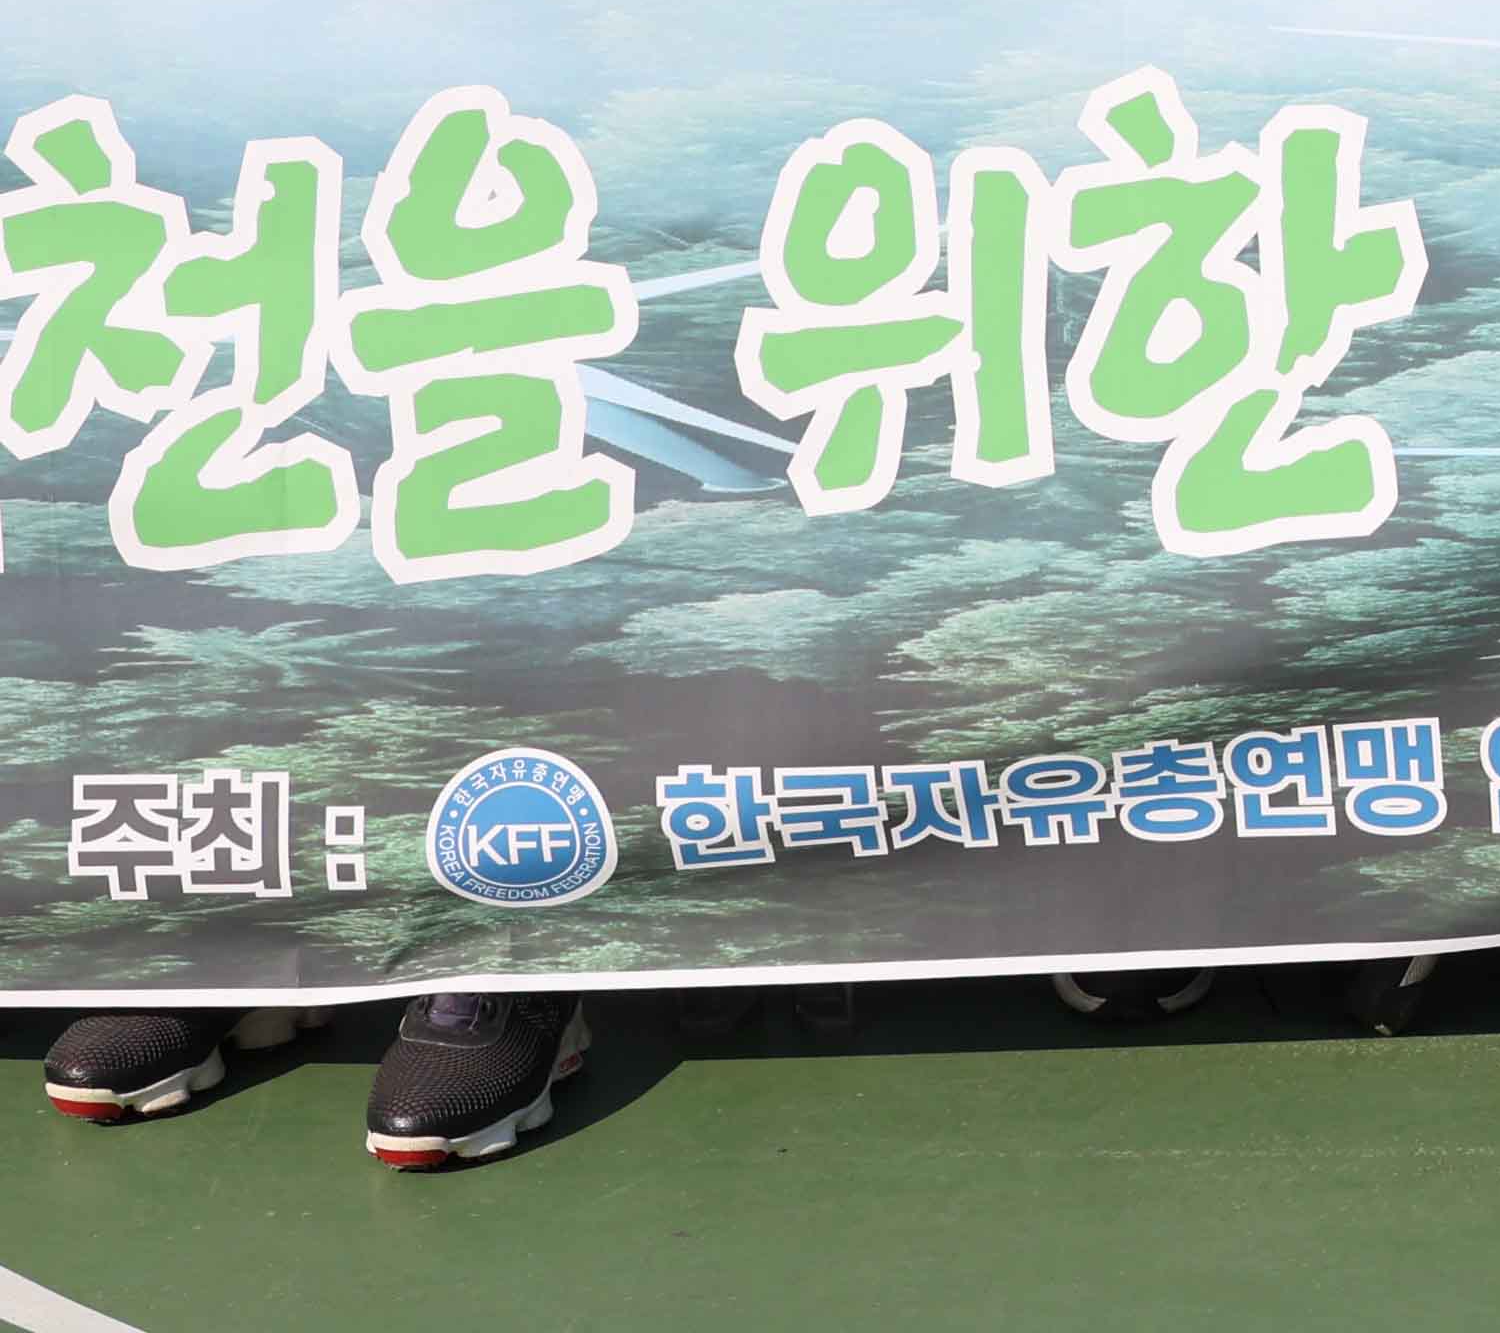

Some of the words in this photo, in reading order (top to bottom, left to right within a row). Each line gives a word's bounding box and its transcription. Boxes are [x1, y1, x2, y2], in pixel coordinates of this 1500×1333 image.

[738, 68, 1426, 555] 위한
[453, 759, 586, 807] 한국자유총연맹
[656, 717, 1444, 870] 한국자유총연맹
[68, 770, 293, 902] 주최
[439, 824, 466, 883] KOREA
[462, 878, 550, 900] FREEDOM
[550, 822, 602, 894] FEDERATION
[466, 822, 573, 868] KFF
